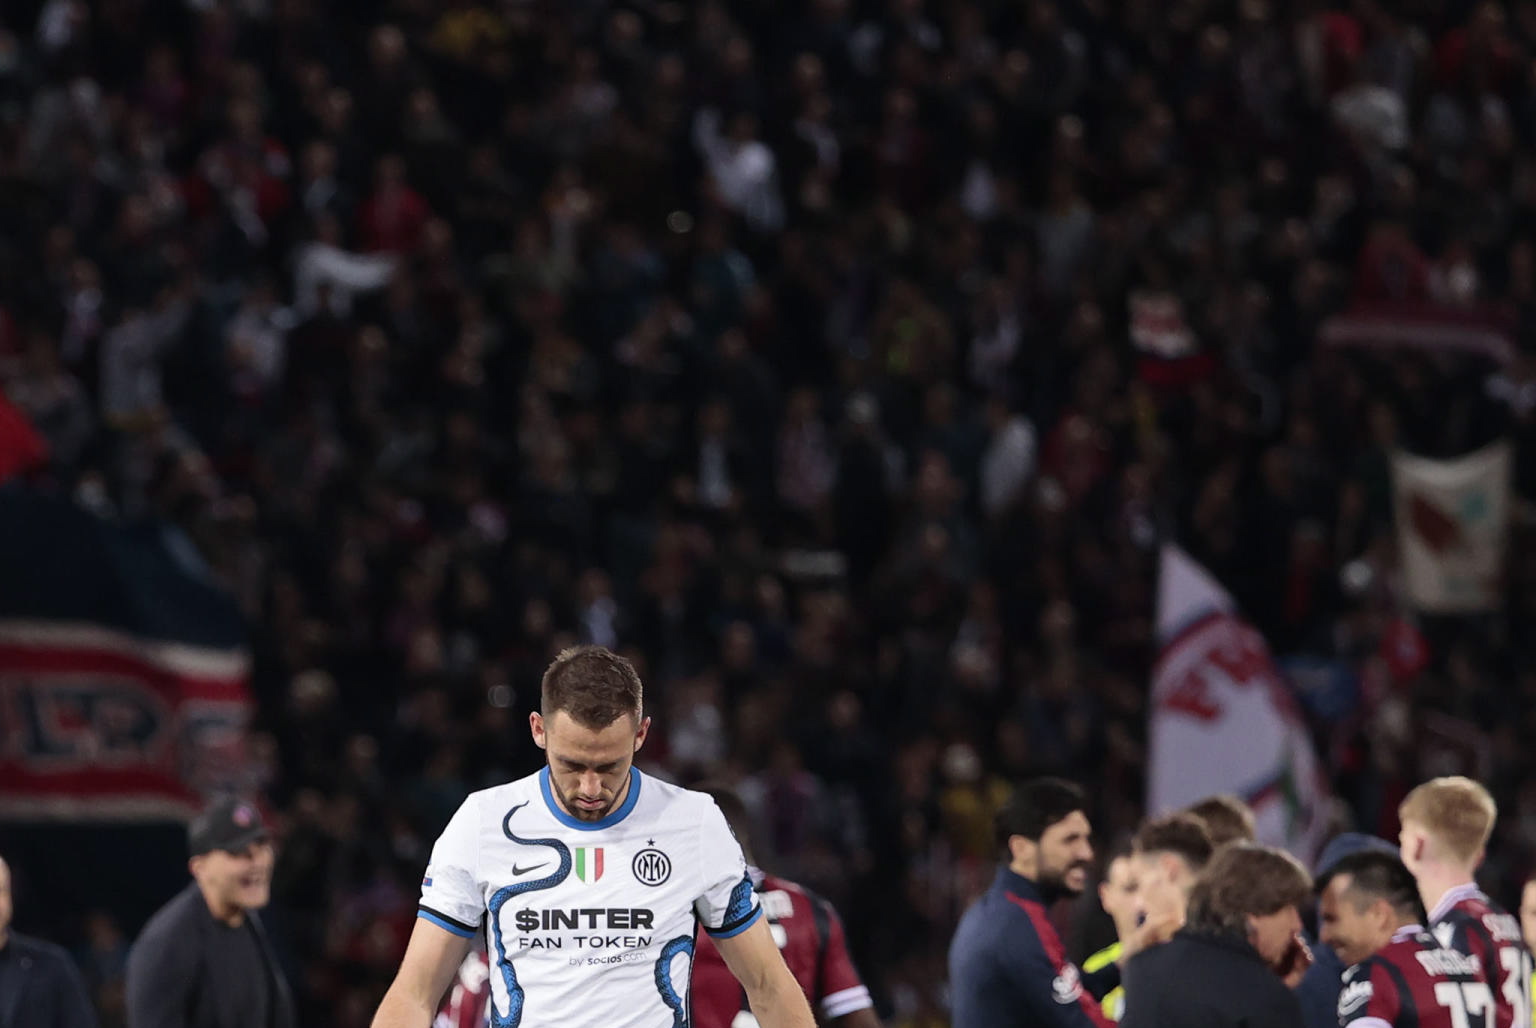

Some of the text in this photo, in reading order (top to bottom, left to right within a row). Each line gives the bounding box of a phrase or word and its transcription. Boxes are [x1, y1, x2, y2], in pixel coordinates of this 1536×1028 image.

[515, 907, 654, 934] $INTER
[519, 936, 652, 949] FAN TOKEN
